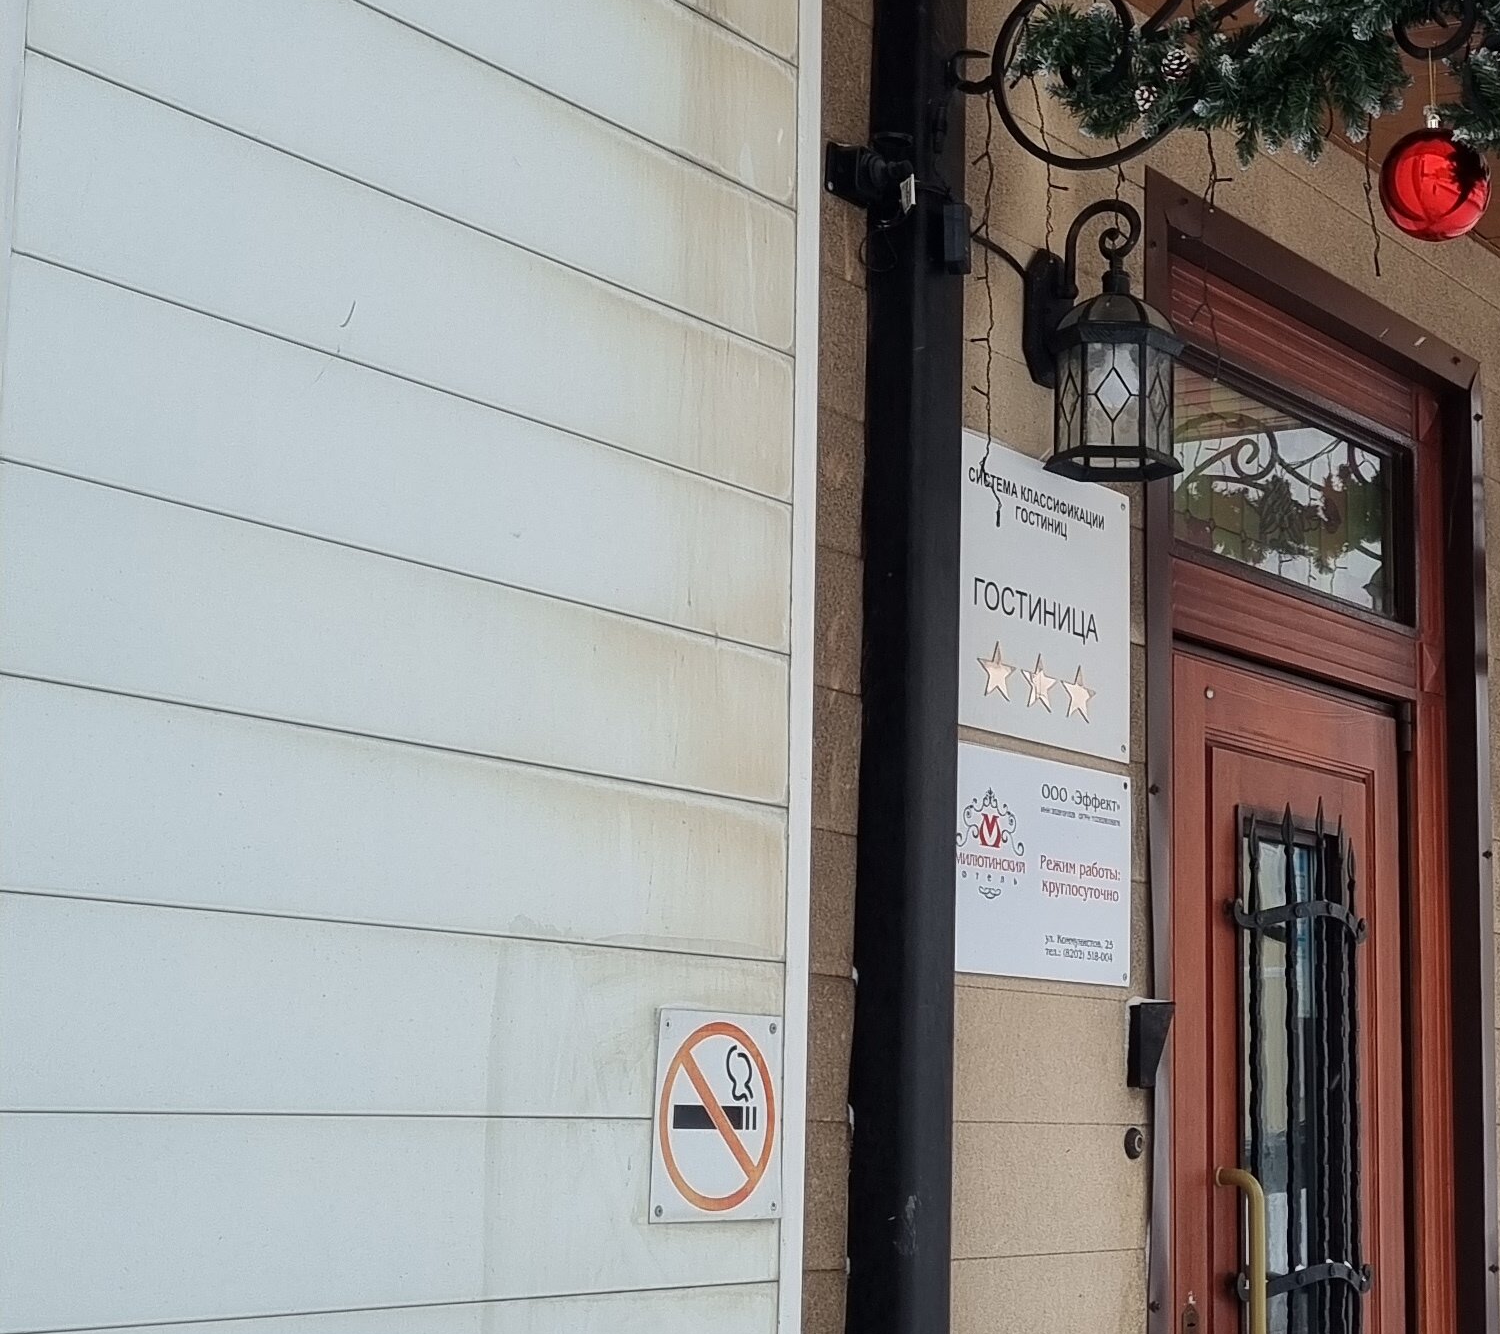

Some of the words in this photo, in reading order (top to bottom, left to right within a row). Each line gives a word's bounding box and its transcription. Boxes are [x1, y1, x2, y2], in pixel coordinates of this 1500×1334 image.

[968, 466, 1018, 499] СИСТЕМА
[1020, 485, 1105, 530] КЛАССИФИКАЦИИ
[1015, 505, 1067, 540] ГОСТИНИЦ
[974, 576, 1099, 645] ГОСТИНИЦА
[1041, 783, 1068, 803] ООО
[1040, 854, 1076, 875] Режим
[1079, 861, 1121, 881] работы:
[1042, 879, 1119, 902] круглосуточно
